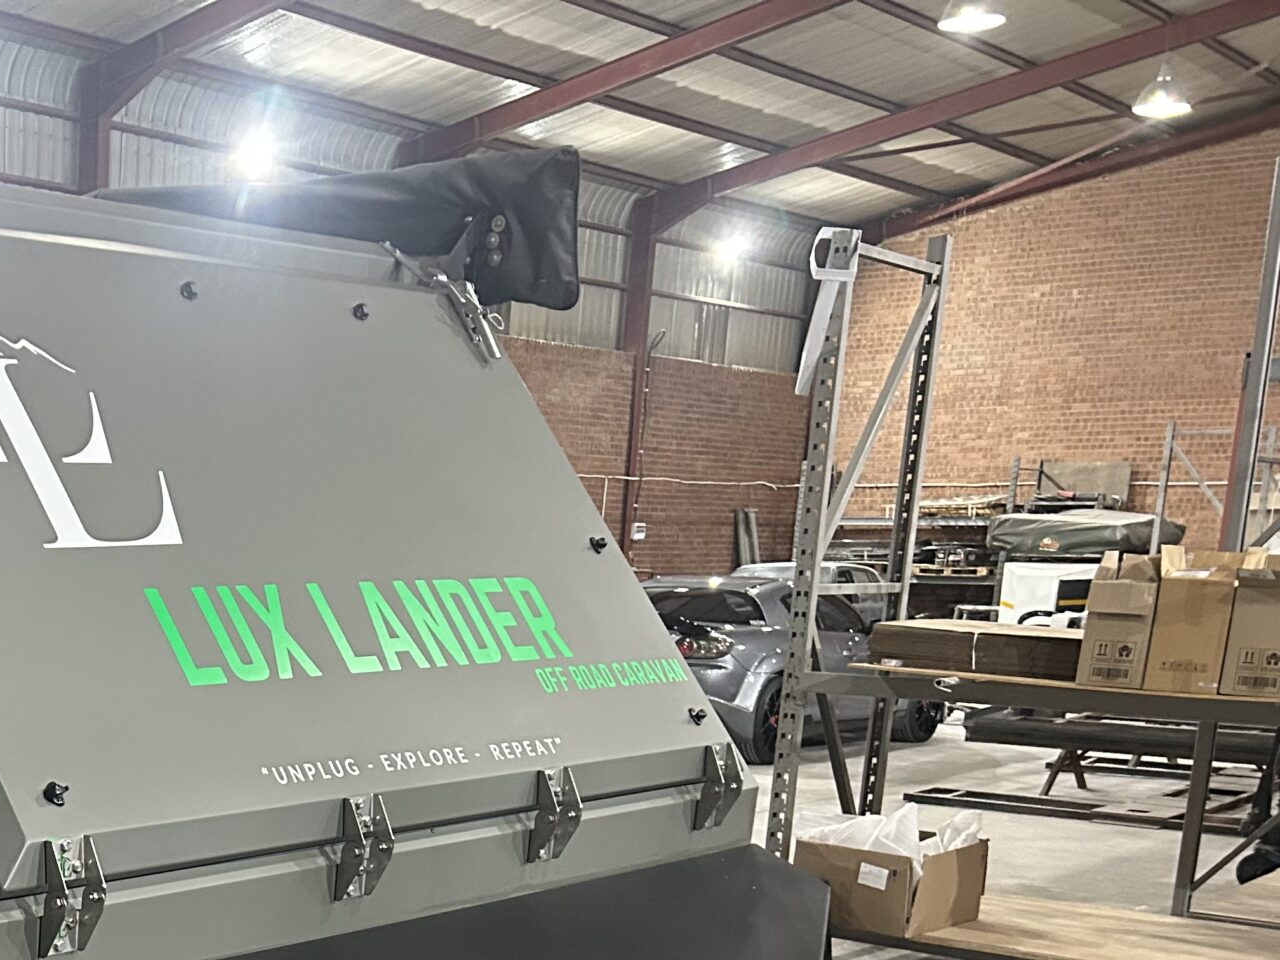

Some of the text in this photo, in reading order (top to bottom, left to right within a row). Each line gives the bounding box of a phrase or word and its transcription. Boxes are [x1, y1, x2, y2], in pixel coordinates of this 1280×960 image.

[143, 576, 575, 687] LUX LANDER
[535, 658, 689, 694] OFF ROAD CARAVAN
[379, 746, 469, 773] EXPLORE
